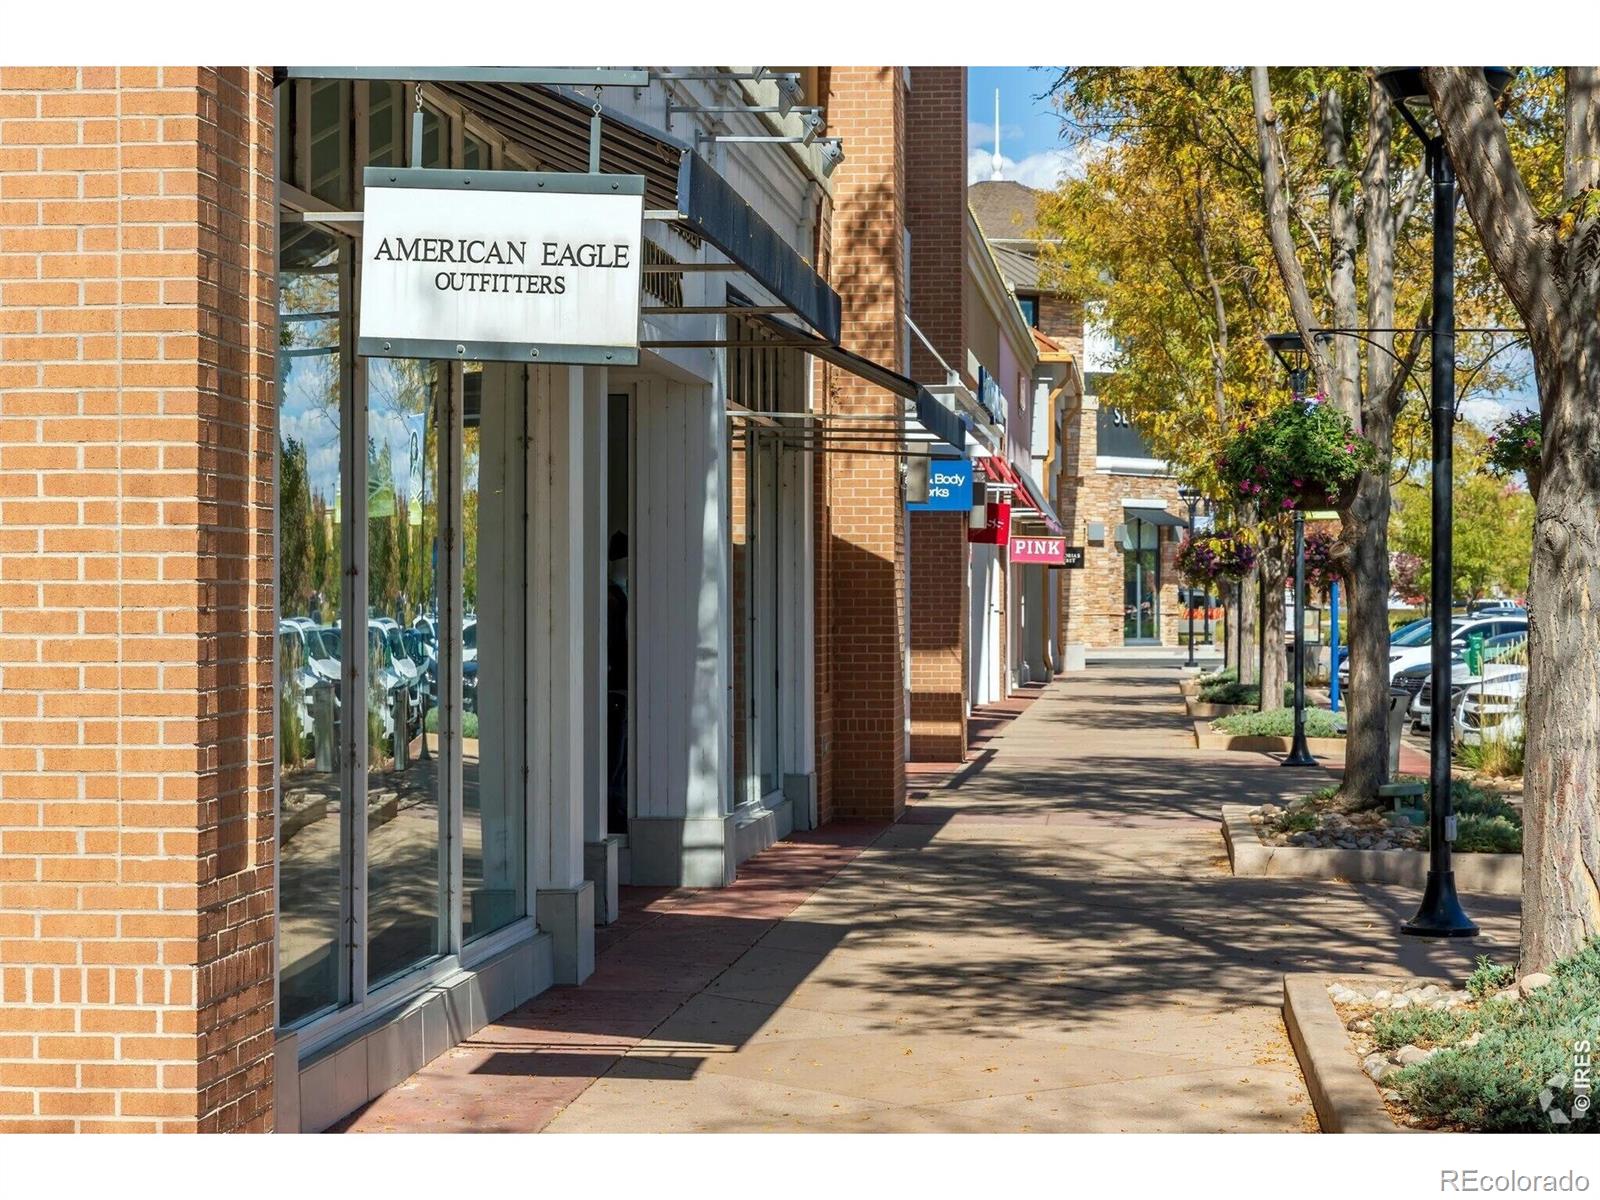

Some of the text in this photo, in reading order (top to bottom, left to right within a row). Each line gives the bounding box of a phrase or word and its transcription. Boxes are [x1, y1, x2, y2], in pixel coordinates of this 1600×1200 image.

[374, 237, 630, 268] AMERICAN EAGLE
[435, 271, 566, 295] OUTFITTERS
[934, 473, 966, 487] Body
[929, 486, 950, 498] rks
[1015, 540, 1061, 555] PINK
